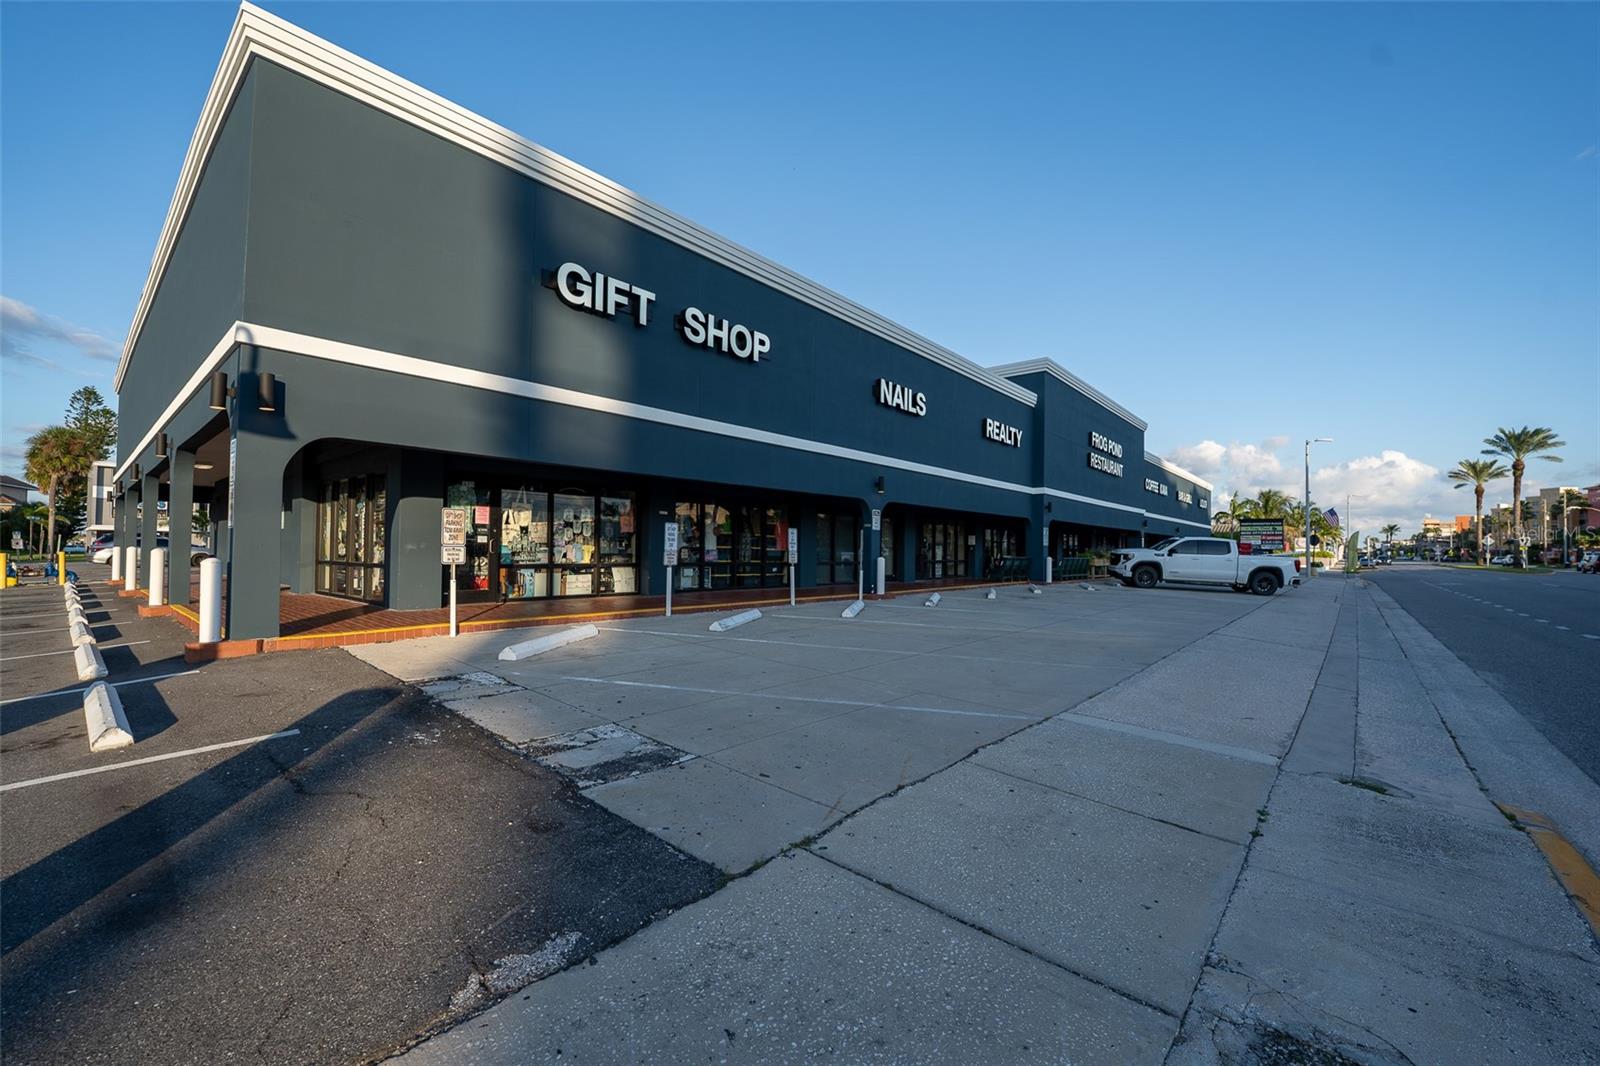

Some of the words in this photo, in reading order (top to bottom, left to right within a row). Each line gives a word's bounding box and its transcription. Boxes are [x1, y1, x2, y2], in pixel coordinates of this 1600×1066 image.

[556, 262, 656, 326] GIFT
[683, 306, 771, 362] SHOP
[880, 378, 927, 417] NAILS
[986, 418, 1023, 448] REALTY
[1092, 431, 1108, 452] FROG
[1108, 439, 1123, 458] POND
[1090, 452, 1124, 478] RESTAURANT
